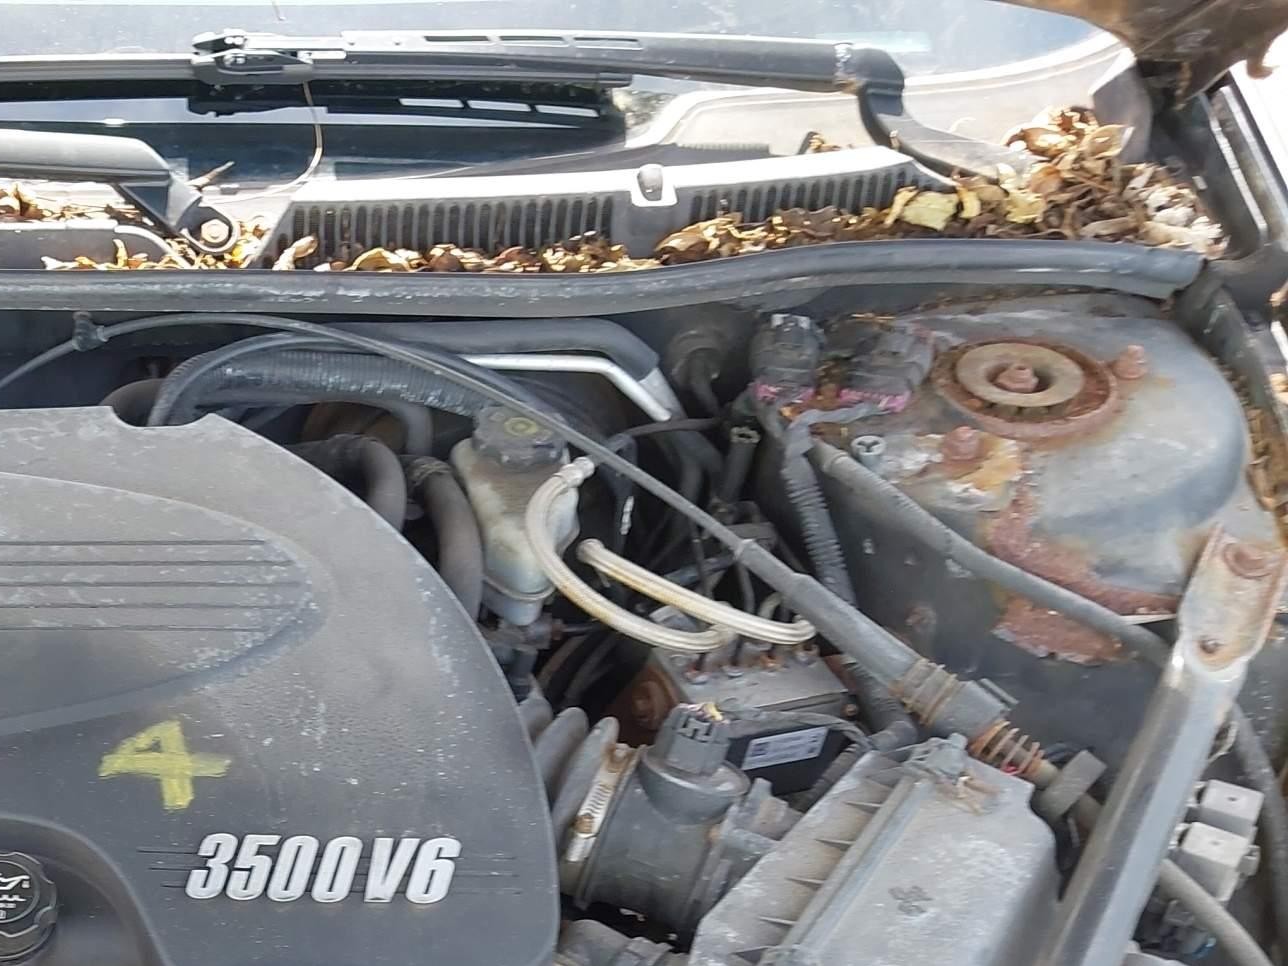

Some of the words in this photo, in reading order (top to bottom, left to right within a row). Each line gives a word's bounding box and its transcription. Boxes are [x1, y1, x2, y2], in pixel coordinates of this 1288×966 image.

[98, 720, 232, 811] 4
[185, 832, 364, 903] 3500
[364, 836, 463, 904] V6
